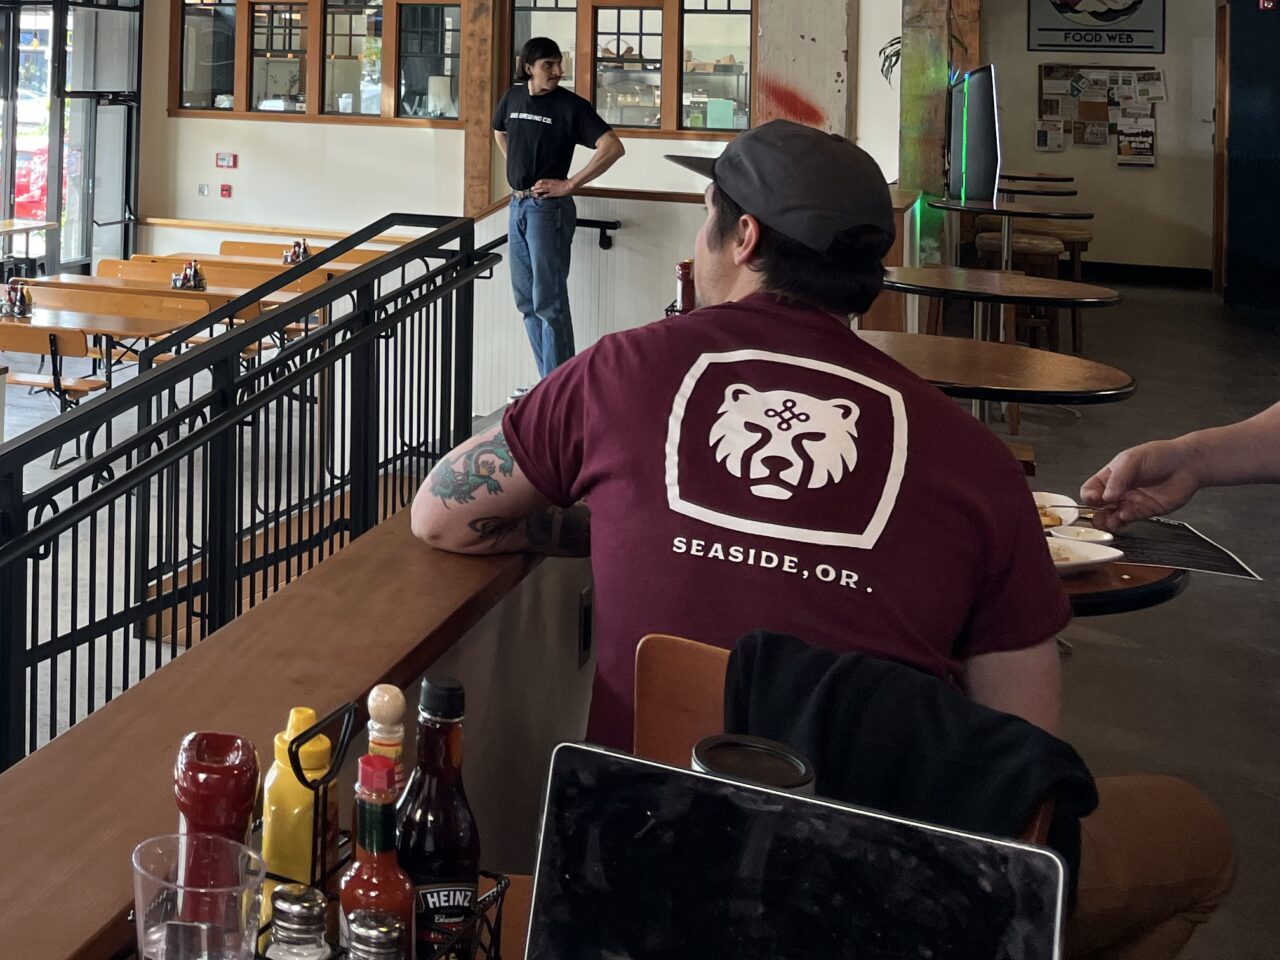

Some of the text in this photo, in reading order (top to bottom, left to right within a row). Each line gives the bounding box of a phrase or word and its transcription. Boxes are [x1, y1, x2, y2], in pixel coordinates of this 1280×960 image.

[1064, 32, 1134, 44] FOOD WEB
[426, 891, 472, 908] HEINZ
